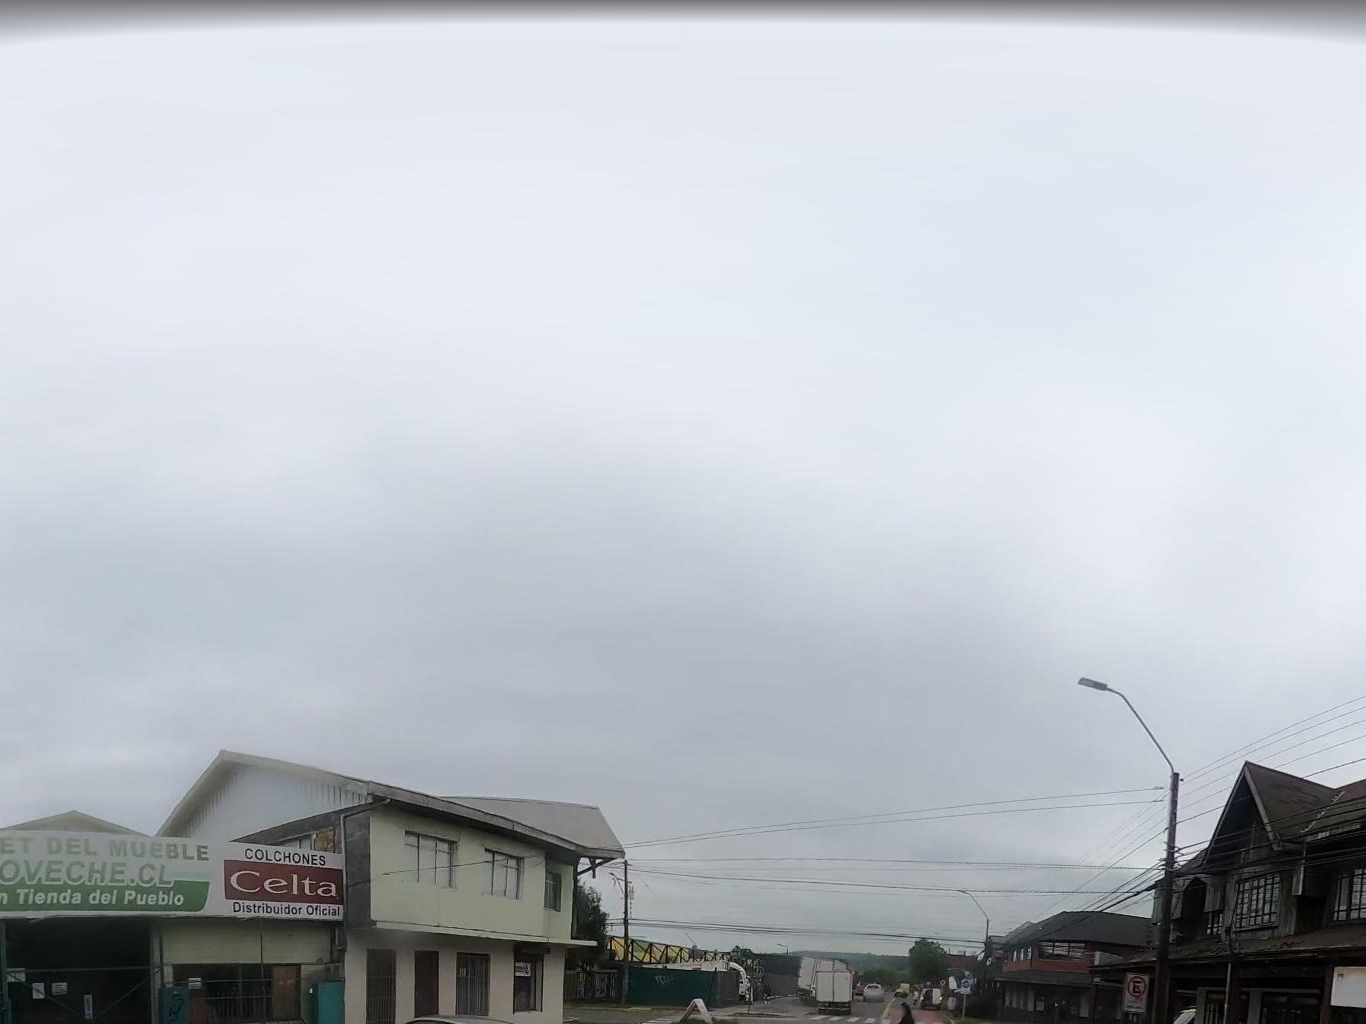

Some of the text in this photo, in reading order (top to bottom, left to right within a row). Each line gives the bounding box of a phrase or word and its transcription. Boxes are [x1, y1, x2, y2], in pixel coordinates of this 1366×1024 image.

[47, 838, 97, 856] DEL
[109, 839, 209, 861] MUEBLE
[245, 848, 326, 866] COLCHONES
[230, 870, 338, 897] Celta
[16, 888, 82, 905] Tienda
[89, 889, 117, 905] del
[124, 890, 184, 906] Pueblo
[233, 902, 340, 917] Distribuidor Oficial
